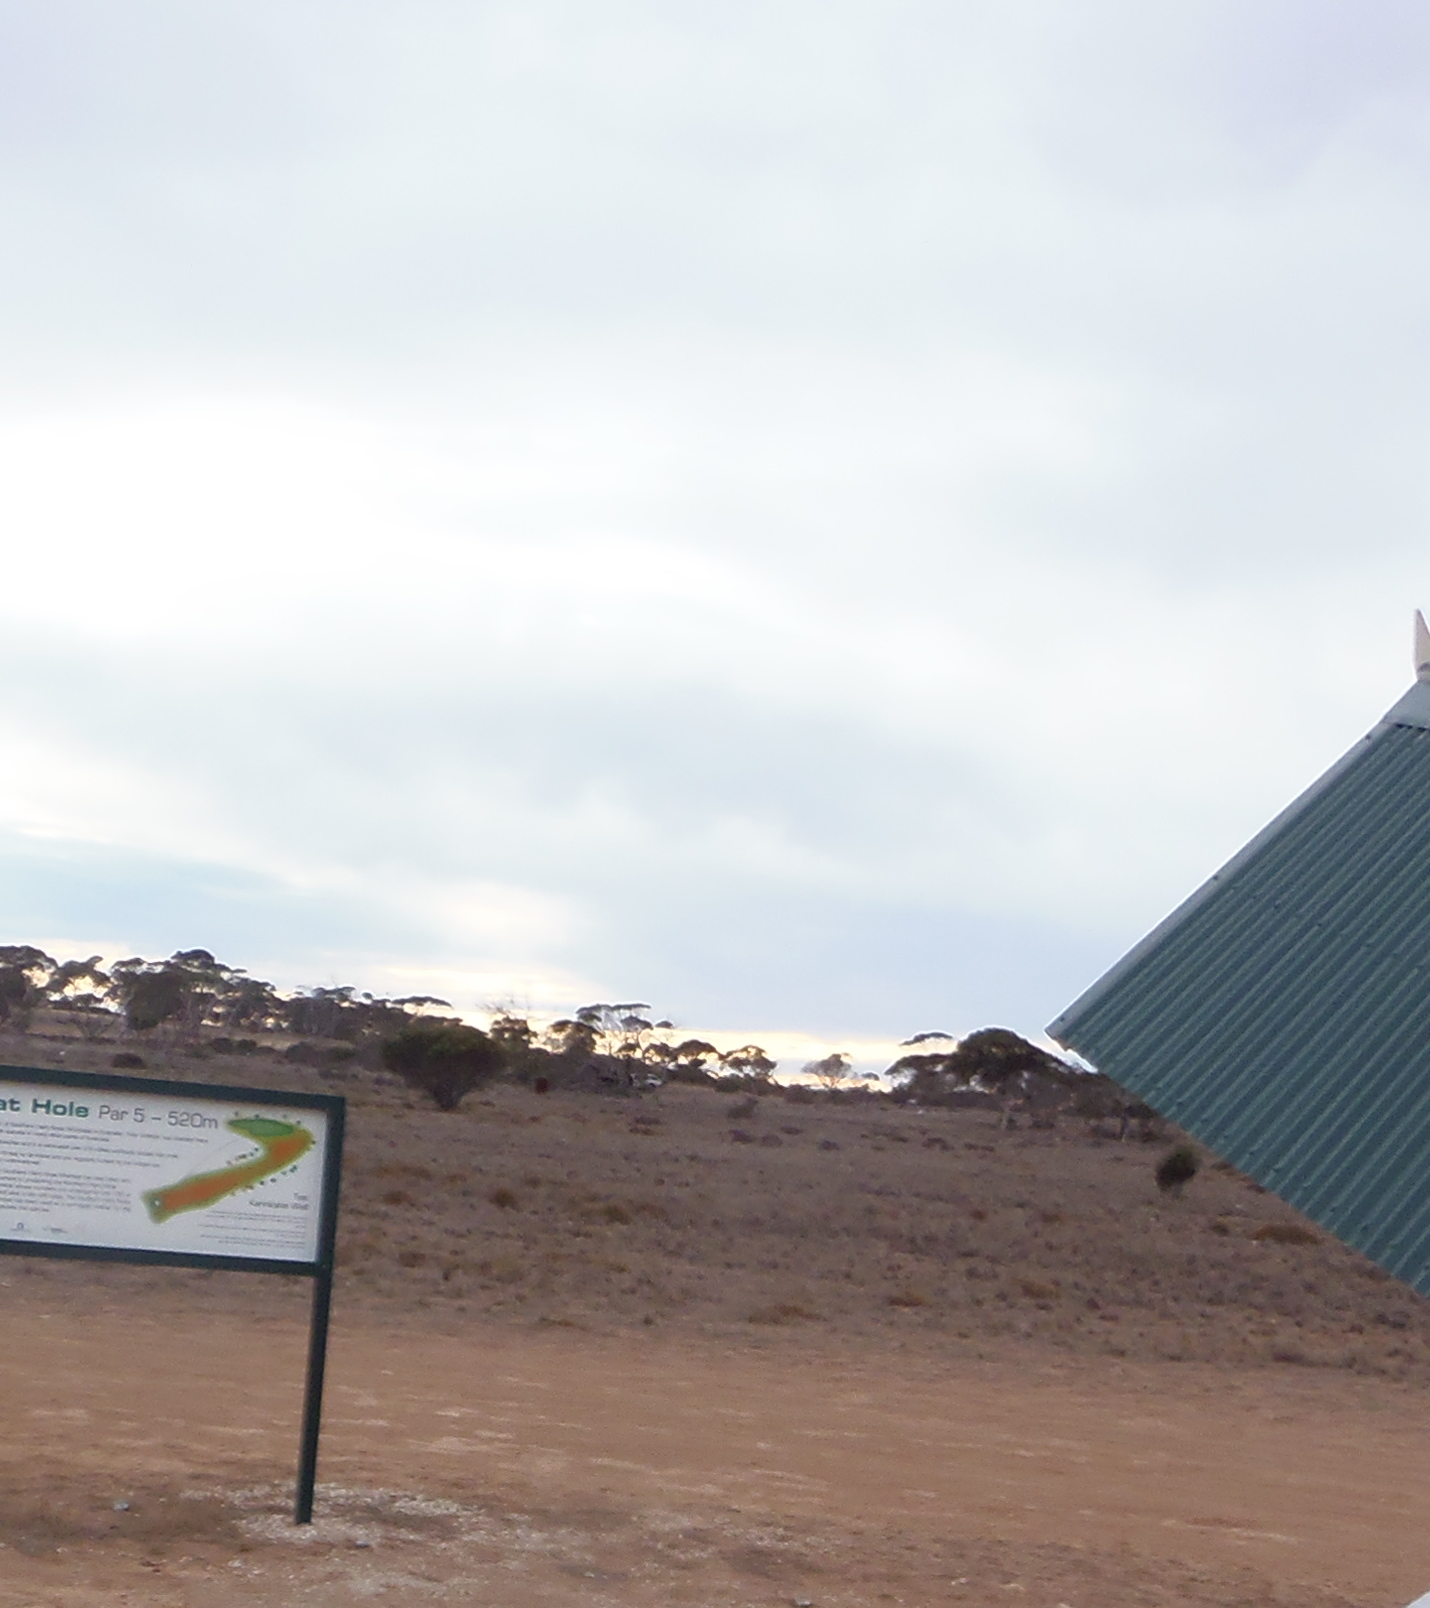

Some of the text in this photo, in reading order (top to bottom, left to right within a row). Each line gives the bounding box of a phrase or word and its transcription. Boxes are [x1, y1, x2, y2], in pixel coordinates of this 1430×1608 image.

[31, 1098, 89, 1118] Hole
[98, 1105, 128, 1121] Par
[133, 1107, 145, 1123] 5
[167, 1110, 218, 1129] 520m
